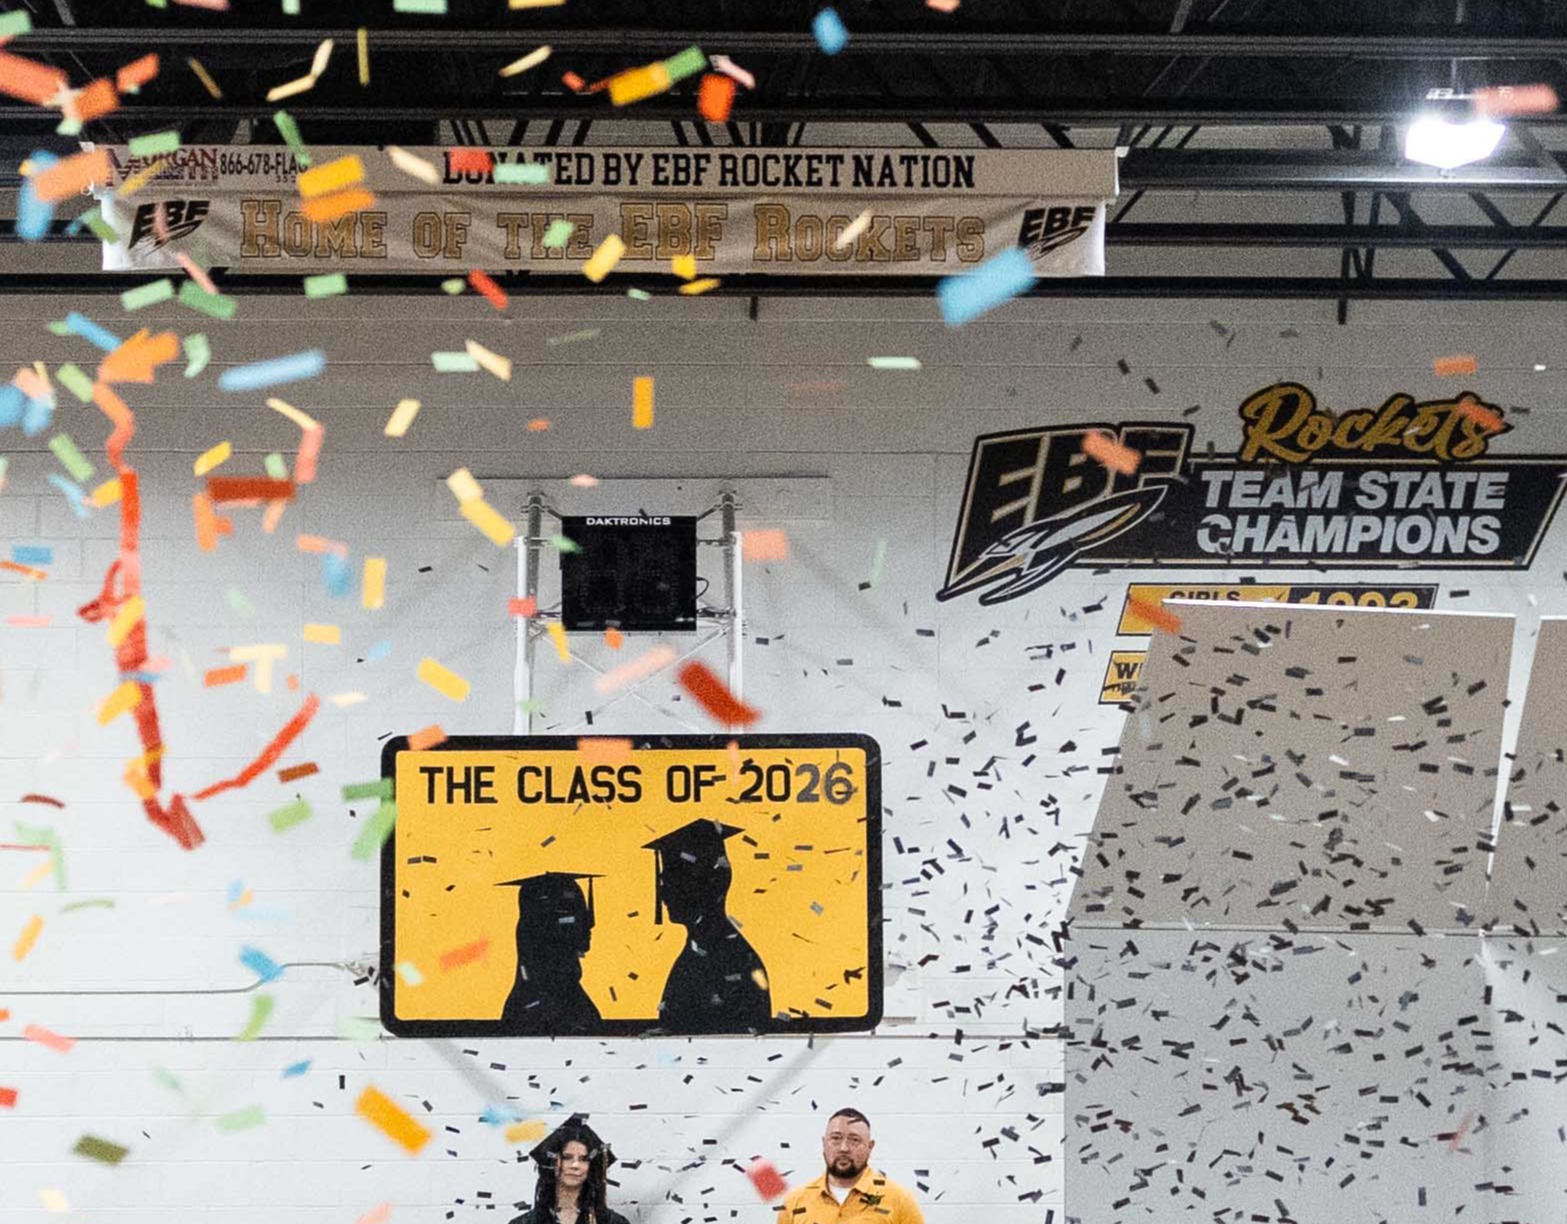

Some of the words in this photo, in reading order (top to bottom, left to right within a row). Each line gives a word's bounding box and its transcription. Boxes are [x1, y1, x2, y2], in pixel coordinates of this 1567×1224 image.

[602, 154, 639, 188] BY
[651, 154, 710, 187] EBF
[719, 153, 850, 187] ROCKET
[852, 154, 975, 188] NATION
[129, 200, 210, 247] EBF
[241, 200, 388, 259] HOME
[413, 212, 470, 260] OF
[497, 213, 593, 260] THE
[619, 203, 728, 260] EBF
[753, 204, 985, 262] ROCKETS
[1240, 390, 1498, 462] Rockets
[1201, 471, 1334, 508] TEAM
[1354, 472, 1508, 509] STATE
[586, 517, 672, 526] DAKTRONICS
[1197, 516, 1500, 553] CHAMPIONS
[419, 766, 497, 804] THE
[517, 765, 643, 804] CLASS
[667, 764, 716, 802] OF
[733, 762, 855, 805] 2026
